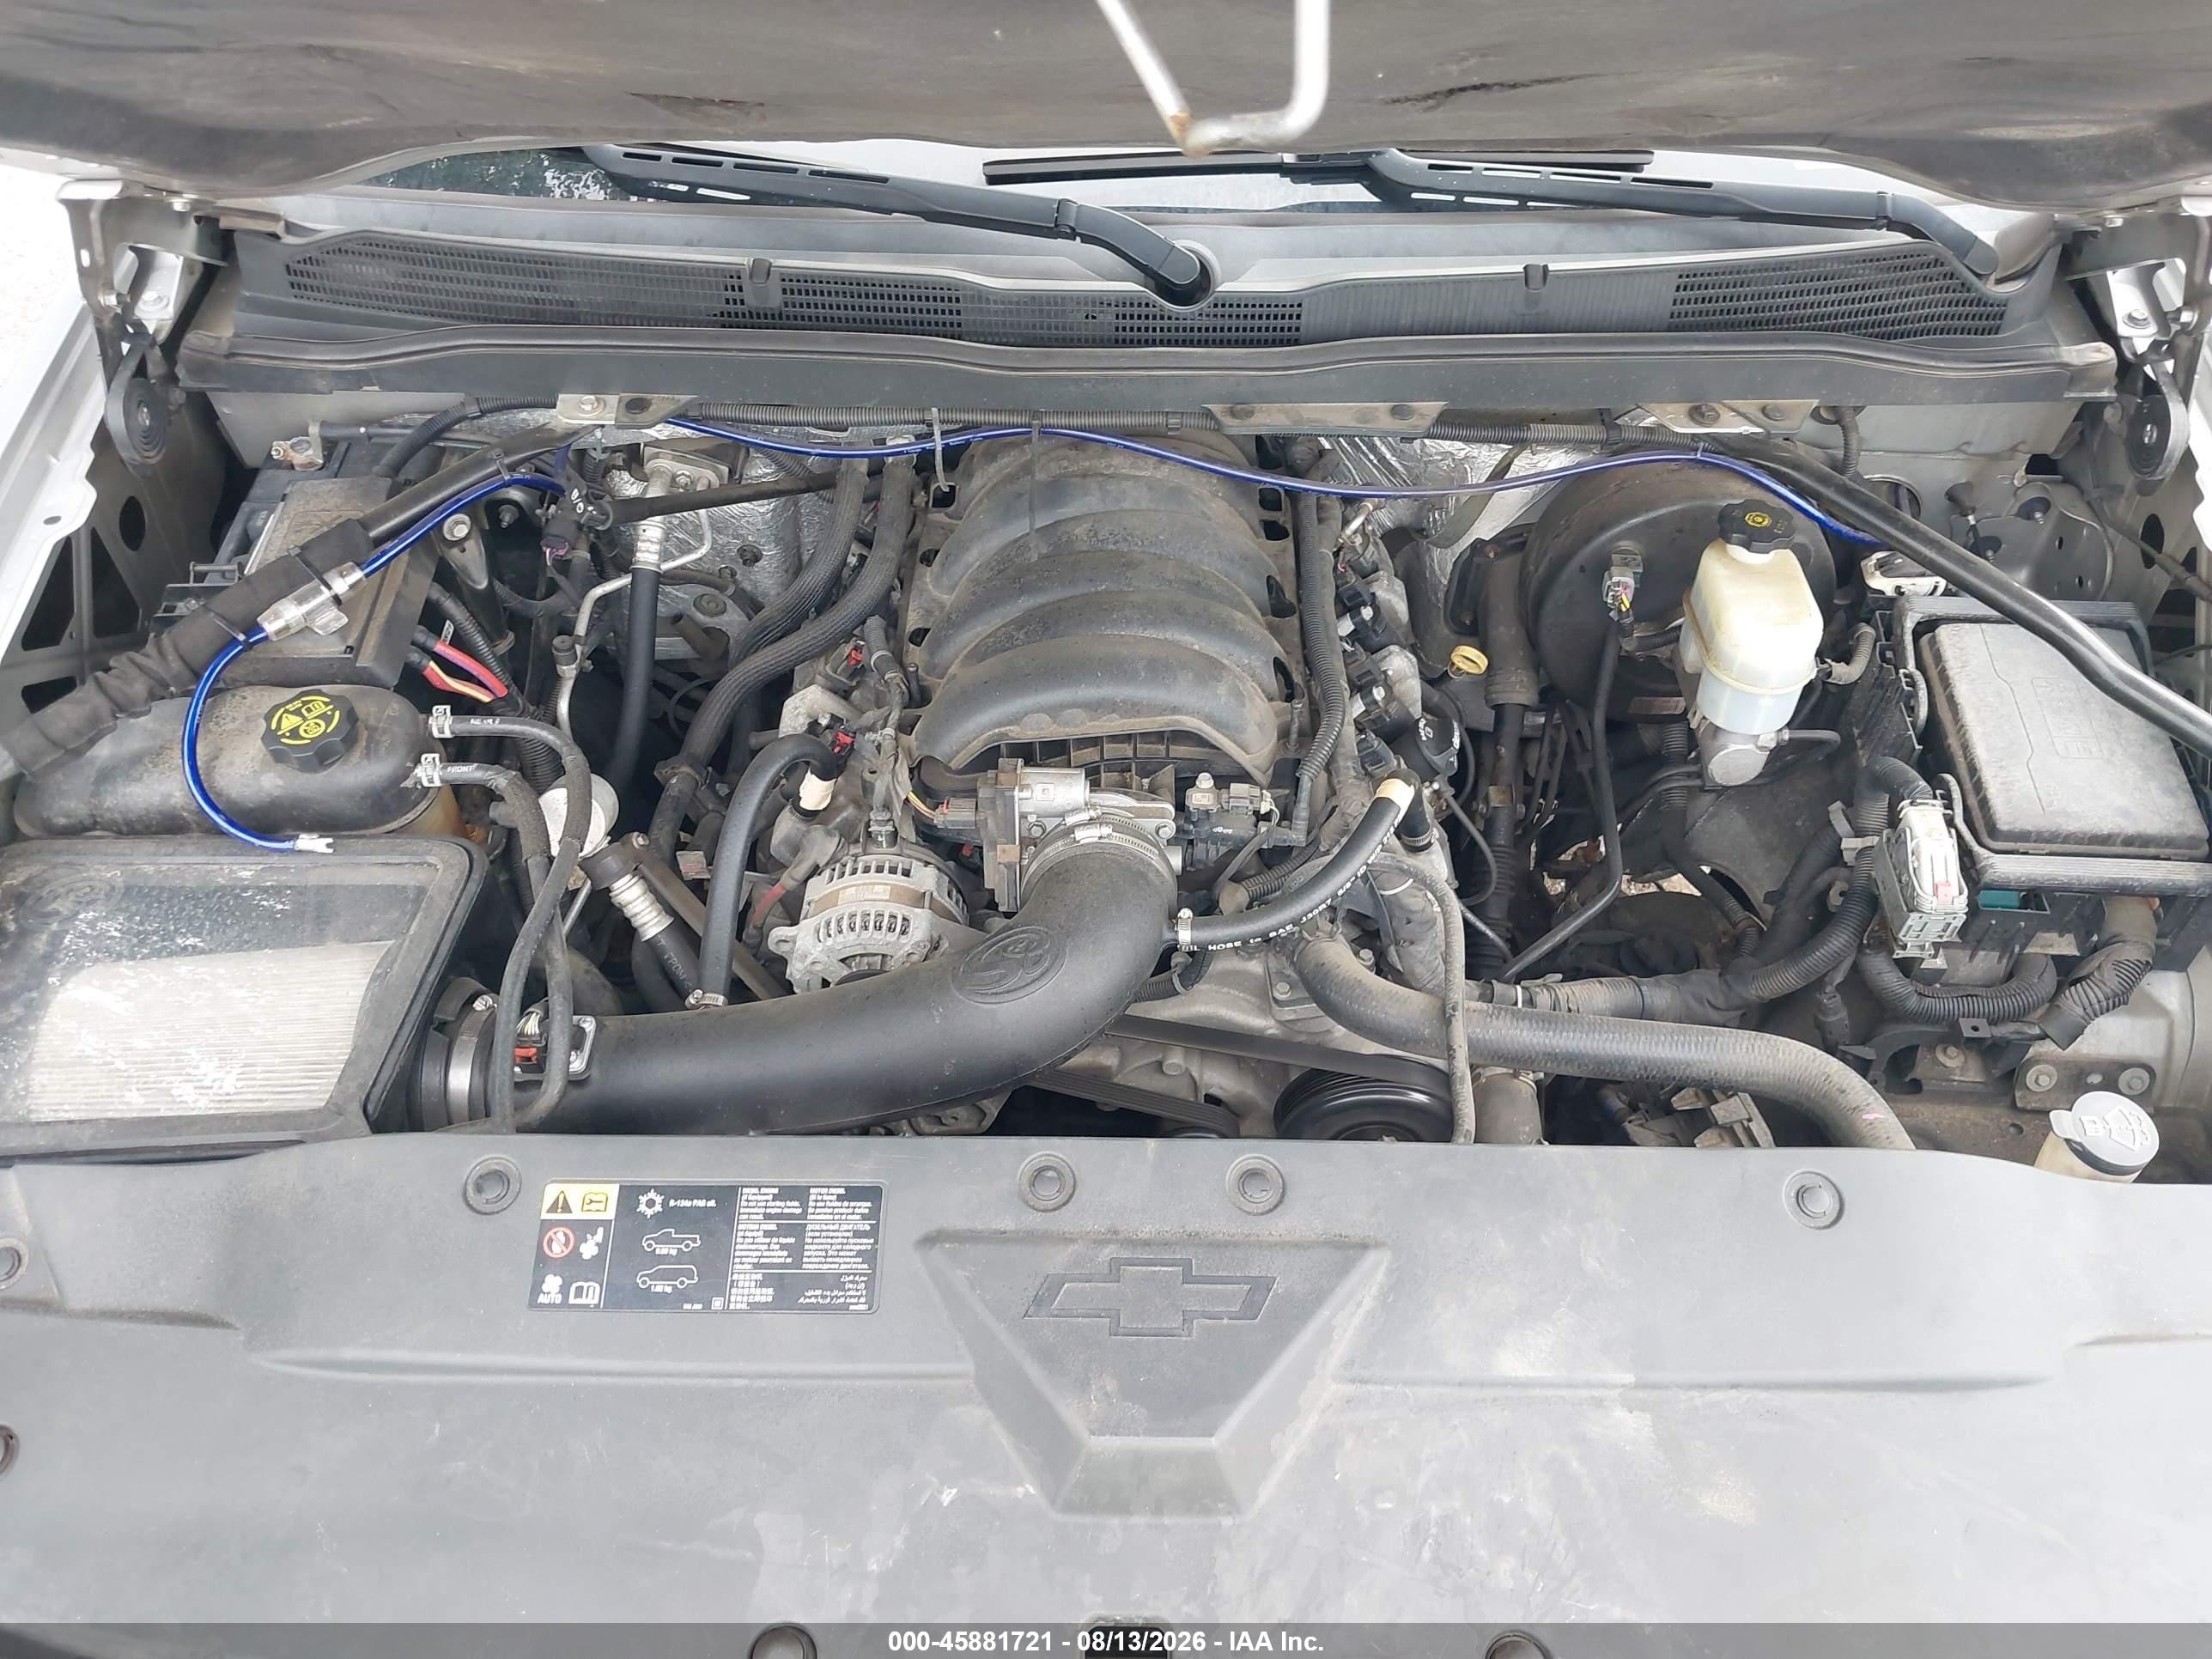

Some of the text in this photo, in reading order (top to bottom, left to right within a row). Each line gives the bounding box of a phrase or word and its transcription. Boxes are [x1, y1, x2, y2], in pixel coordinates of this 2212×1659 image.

[1208, 941, 1242, 951] HOSE
[1269, 923, 1293, 938] SAE
[538, 1293, 562, 1304] AUTO
